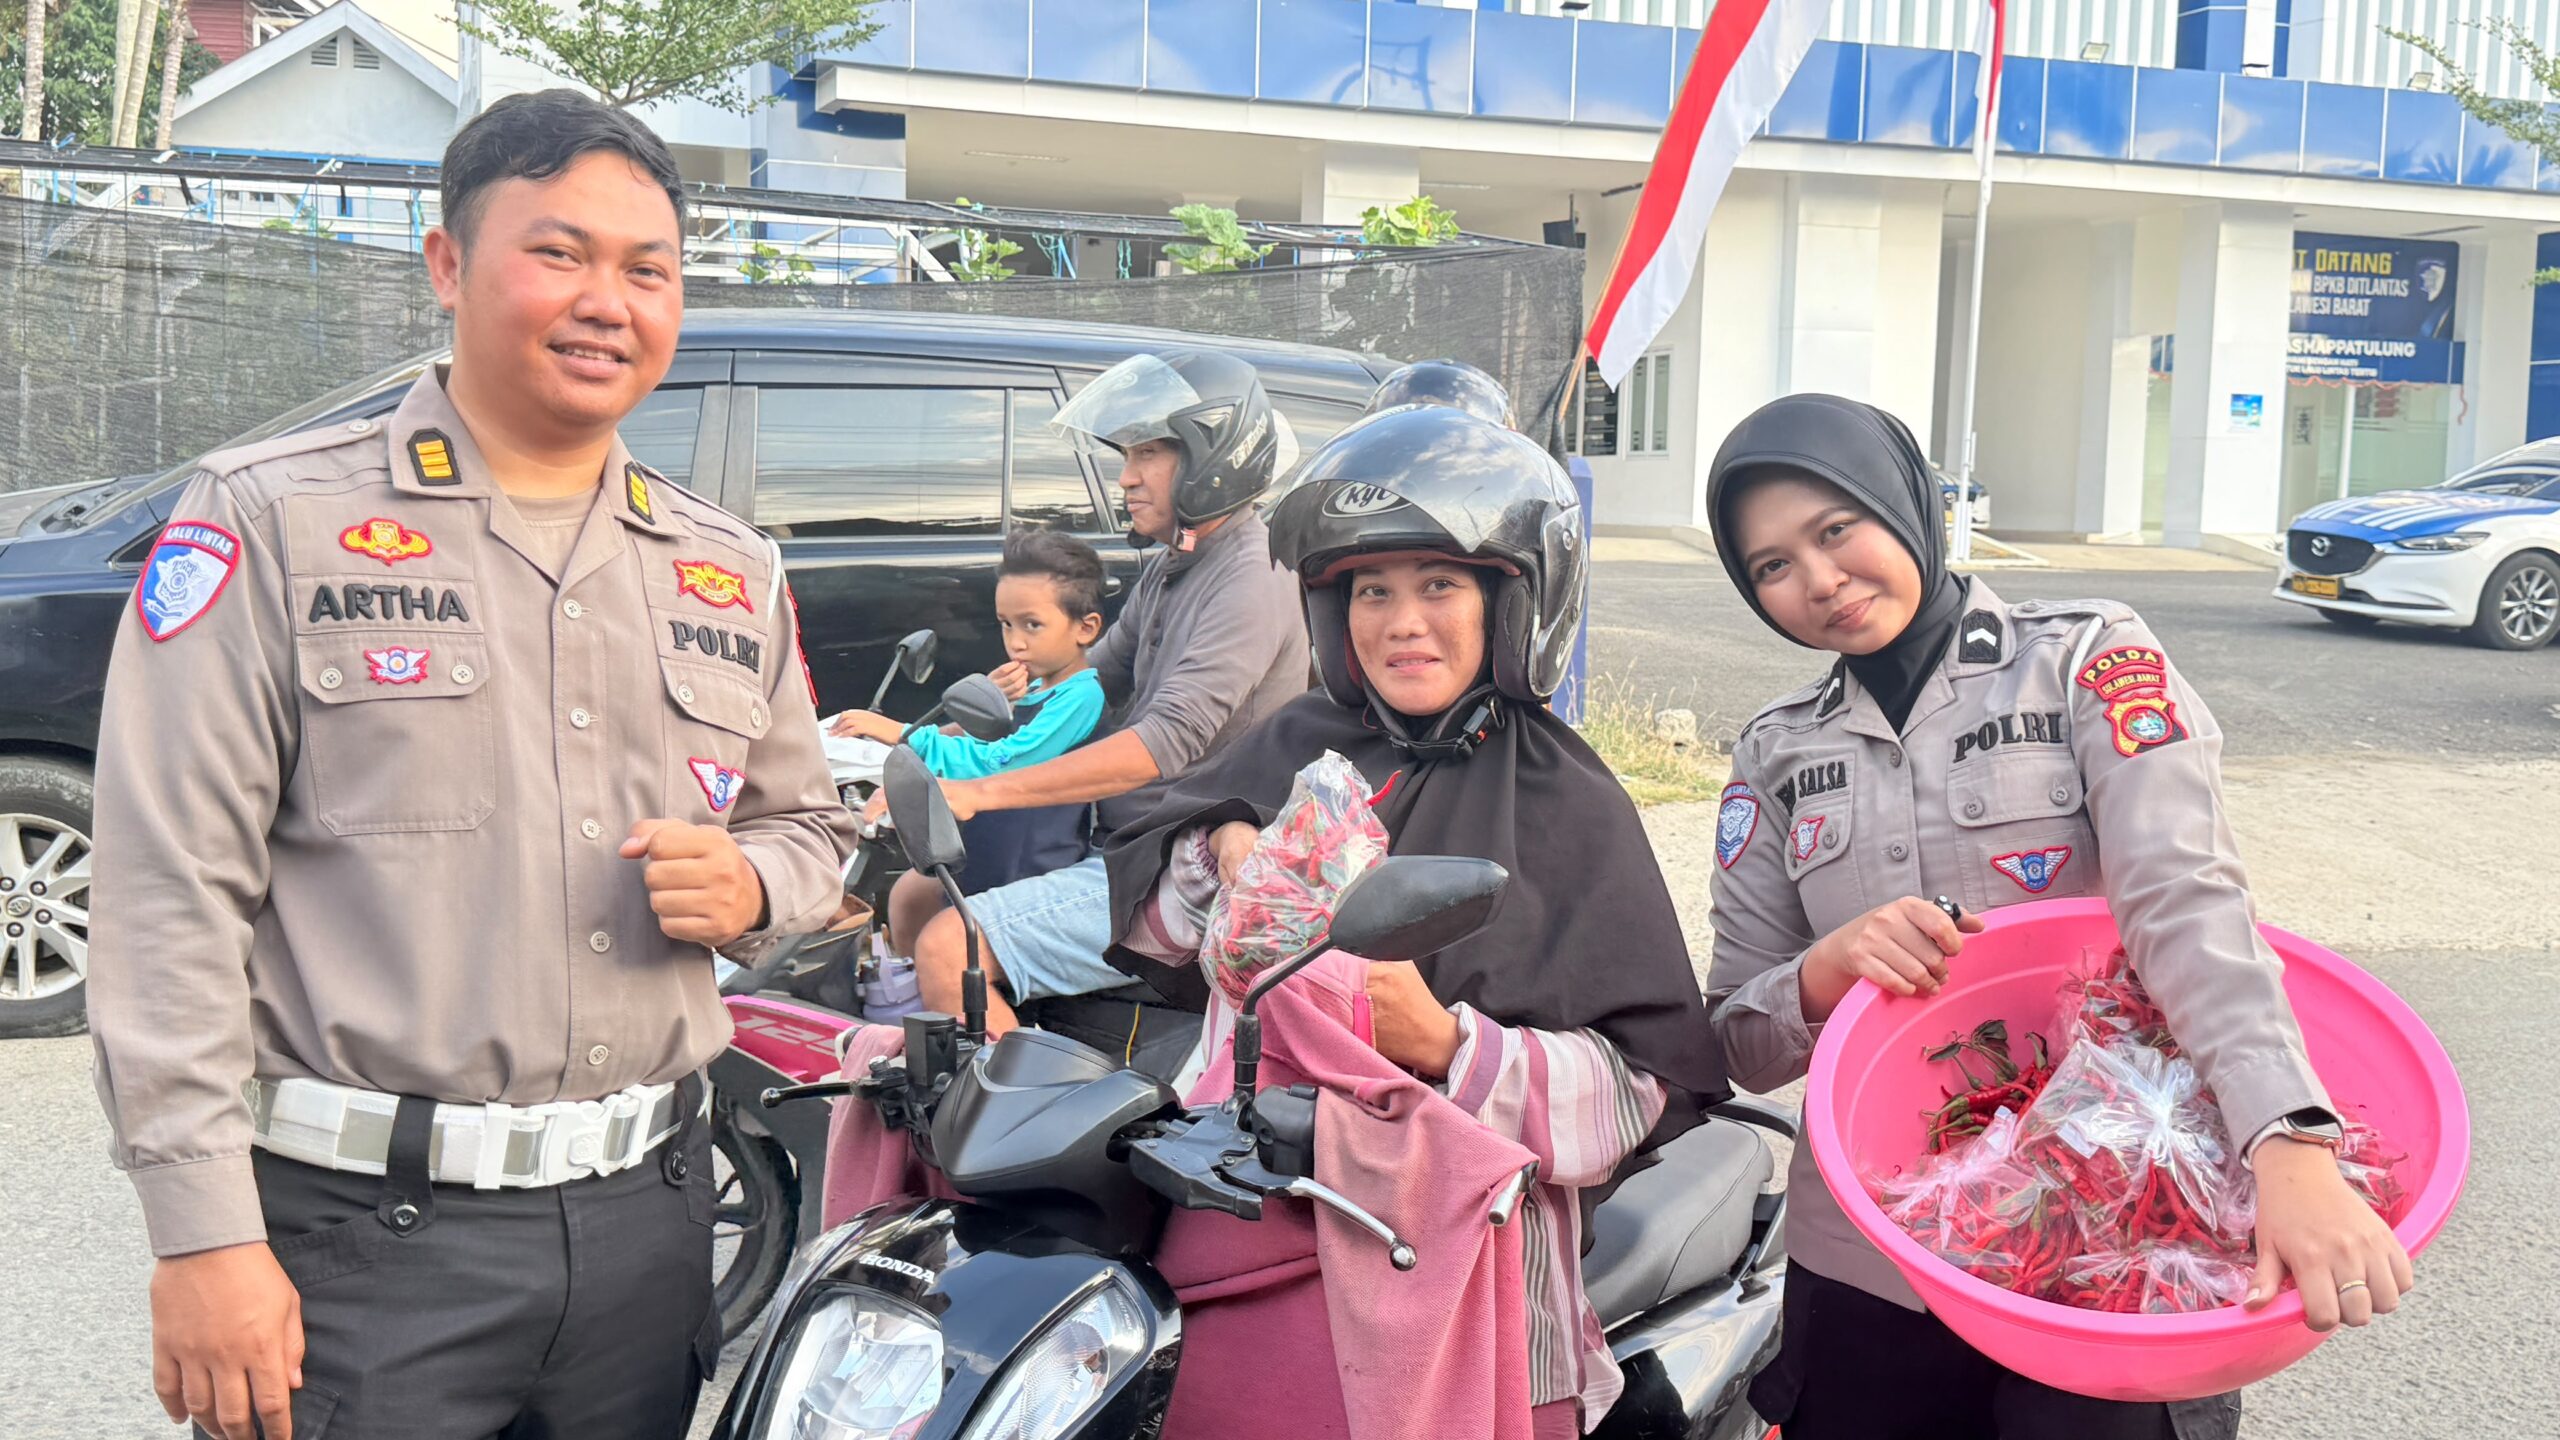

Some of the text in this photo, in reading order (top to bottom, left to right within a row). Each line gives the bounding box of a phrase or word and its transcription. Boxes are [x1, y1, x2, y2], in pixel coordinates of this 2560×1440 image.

[2315, 249, 2392, 275] DATANG
[2313, 275, 2345, 294] BPKB
[2346, 277, 2409, 297] DITLANTAS
[2332, 297, 2371, 316] BARAT
[194, 527, 234, 554] LINTAS
[308, 583, 470, 623] ARTHA
[668, 620, 760, 674] POLRI
[2083, 649, 2158, 682] POLDA
[1952, 711, 2064, 764] POLRI
[1798, 761, 1847, 798] SALSA
[859, 1250, 936, 1284] HONDA
